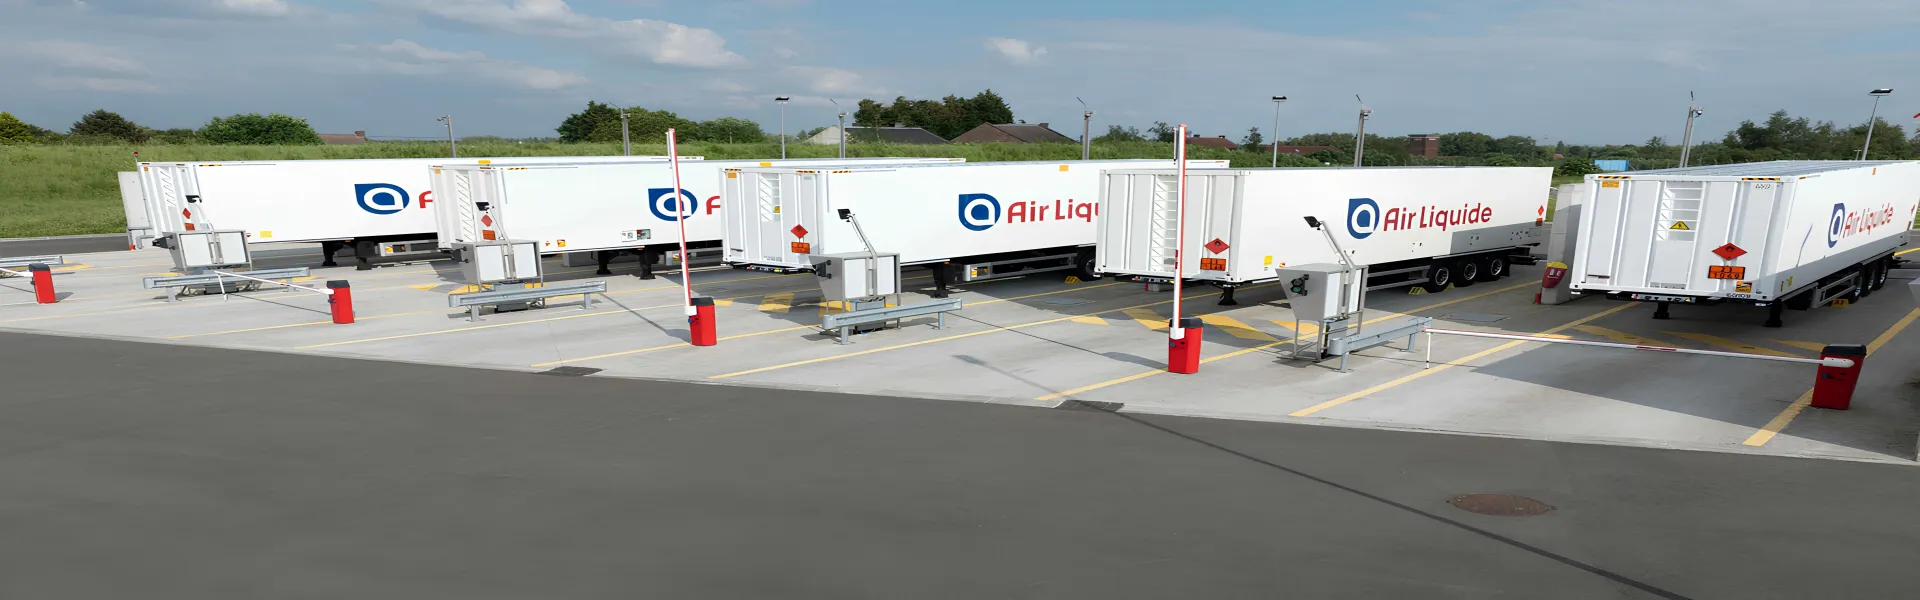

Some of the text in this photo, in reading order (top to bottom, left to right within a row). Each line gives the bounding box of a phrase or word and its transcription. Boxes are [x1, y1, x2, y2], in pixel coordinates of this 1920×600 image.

[1007, 200, 1050, 224] Air
[1383, 202, 1492, 232] Air Liquide
[1841, 202, 1894, 239] Air Liquide
